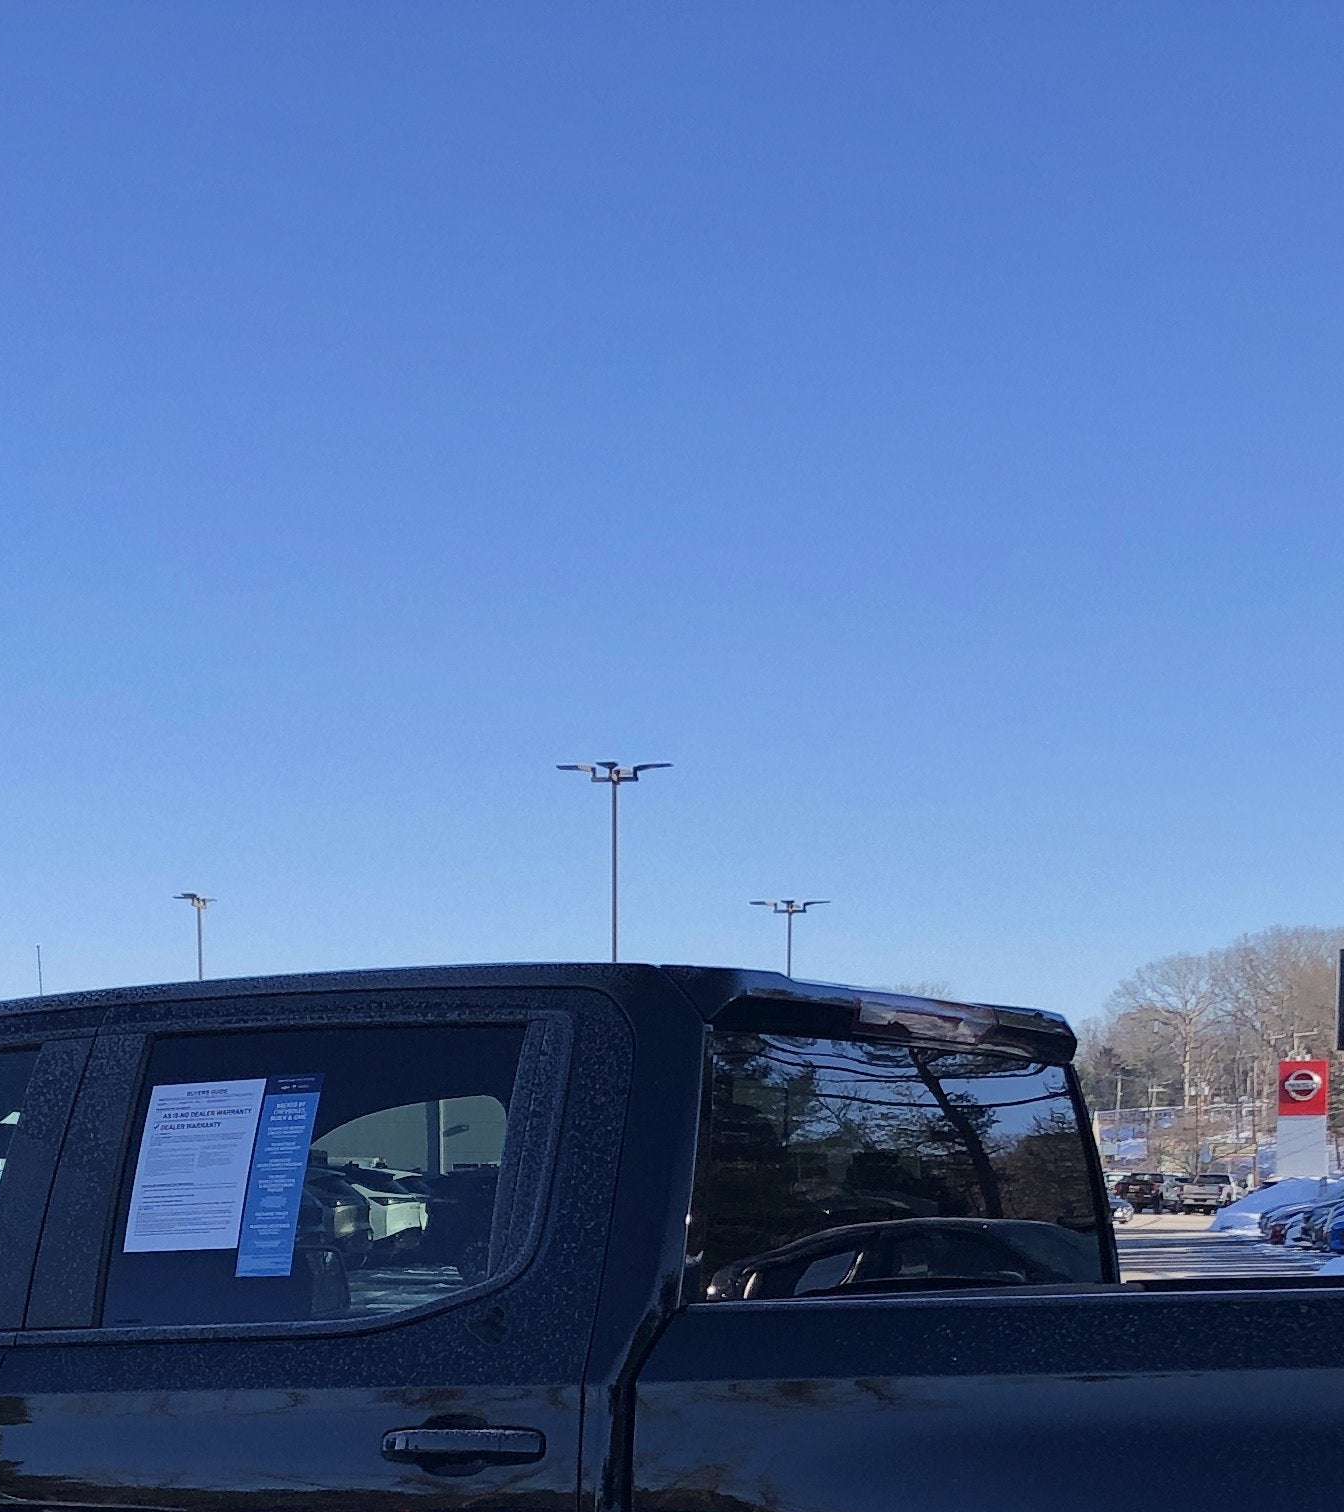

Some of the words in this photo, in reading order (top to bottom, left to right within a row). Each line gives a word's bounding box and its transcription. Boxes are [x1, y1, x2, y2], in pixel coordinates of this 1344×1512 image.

[190, 1110, 215, 1118] DEALER
[216, 1108, 253, 1117] WARRANTY
[160, 1123, 185, 1131] DEALER
